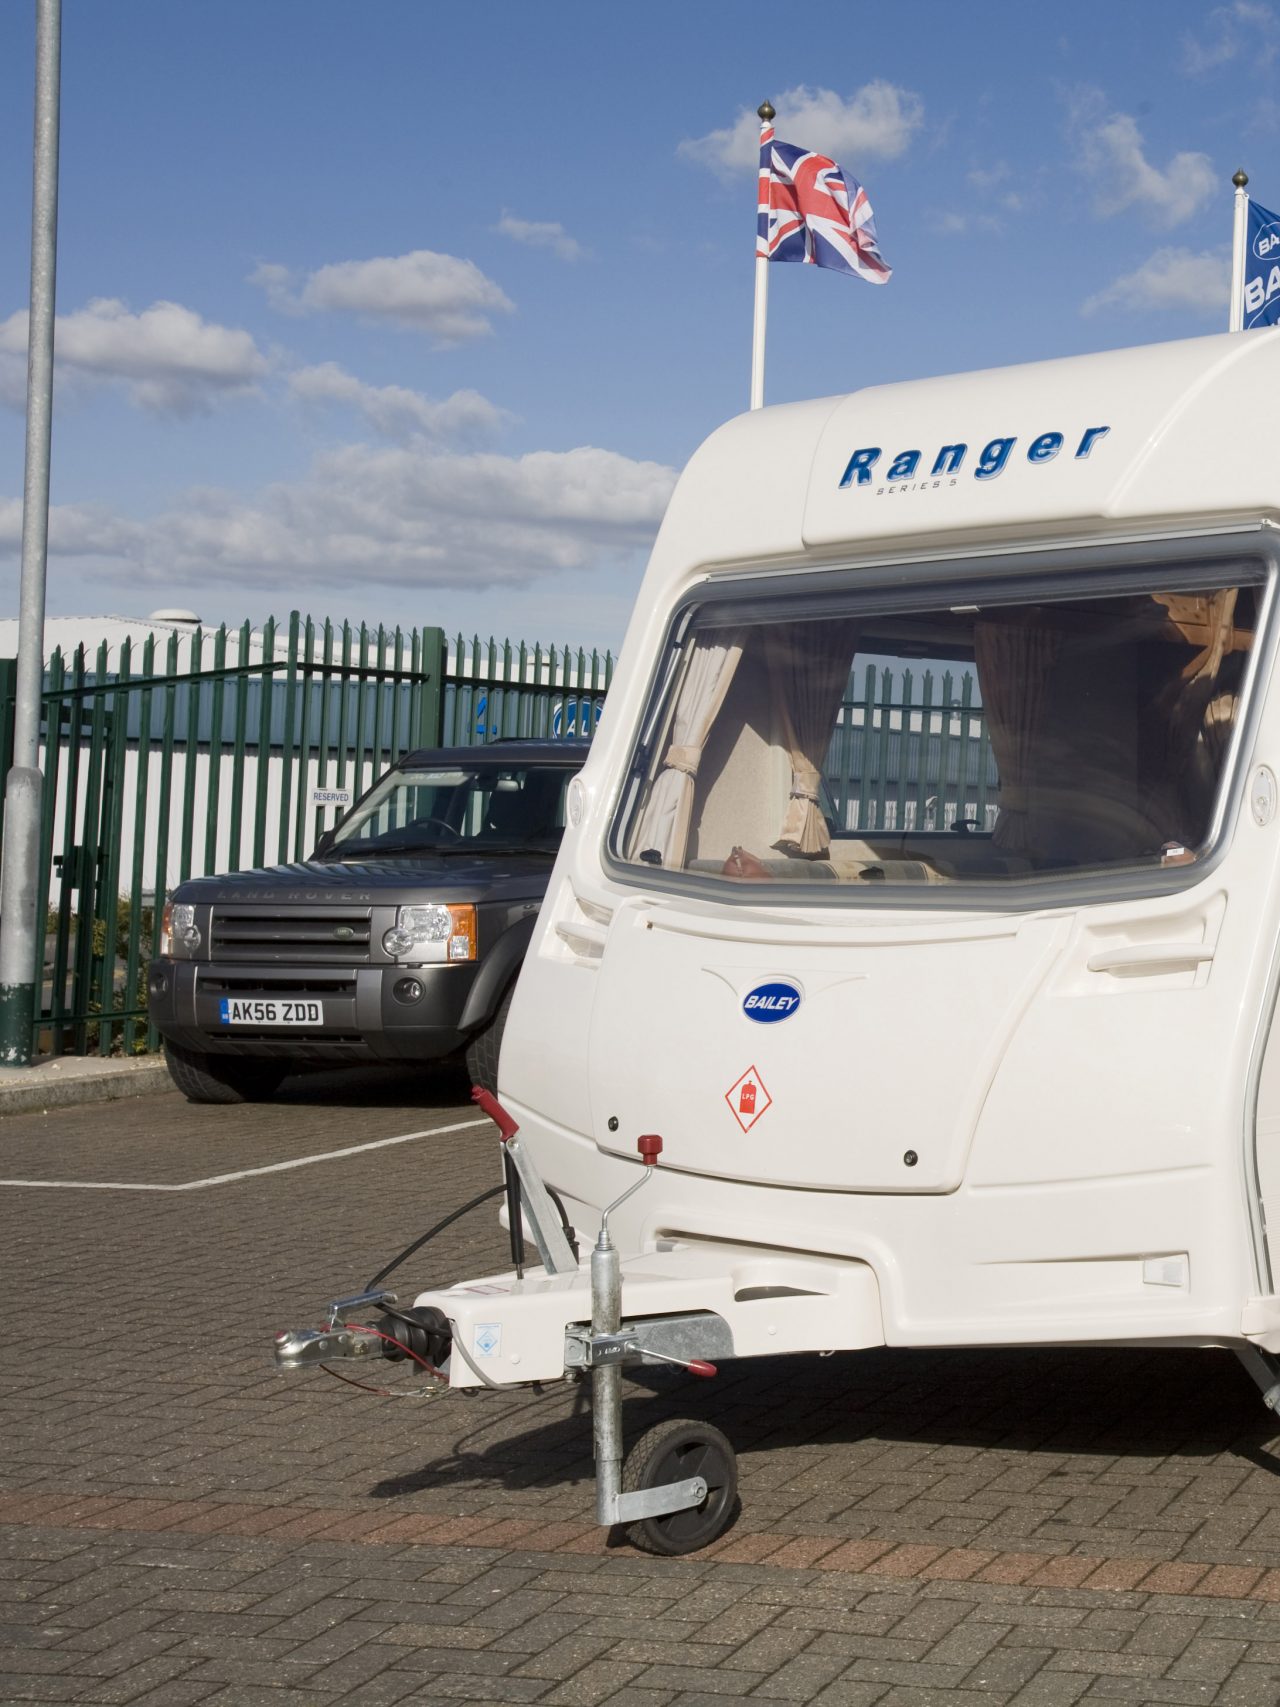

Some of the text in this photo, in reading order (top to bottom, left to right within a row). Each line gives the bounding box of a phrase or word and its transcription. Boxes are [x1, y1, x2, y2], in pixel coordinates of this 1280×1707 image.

[838, 426, 1111, 489] Ranger
[876, 480, 941, 495] SERIES
[313, 792, 349, 802] RESERVED
[217, 891, 371, 900] LAND ROVER
[744, 995, 799, 1010] BAILEY
[232, 1002, 319, 1022] AK56 ZDD
[742, 1093, 755, 1101] LPG
